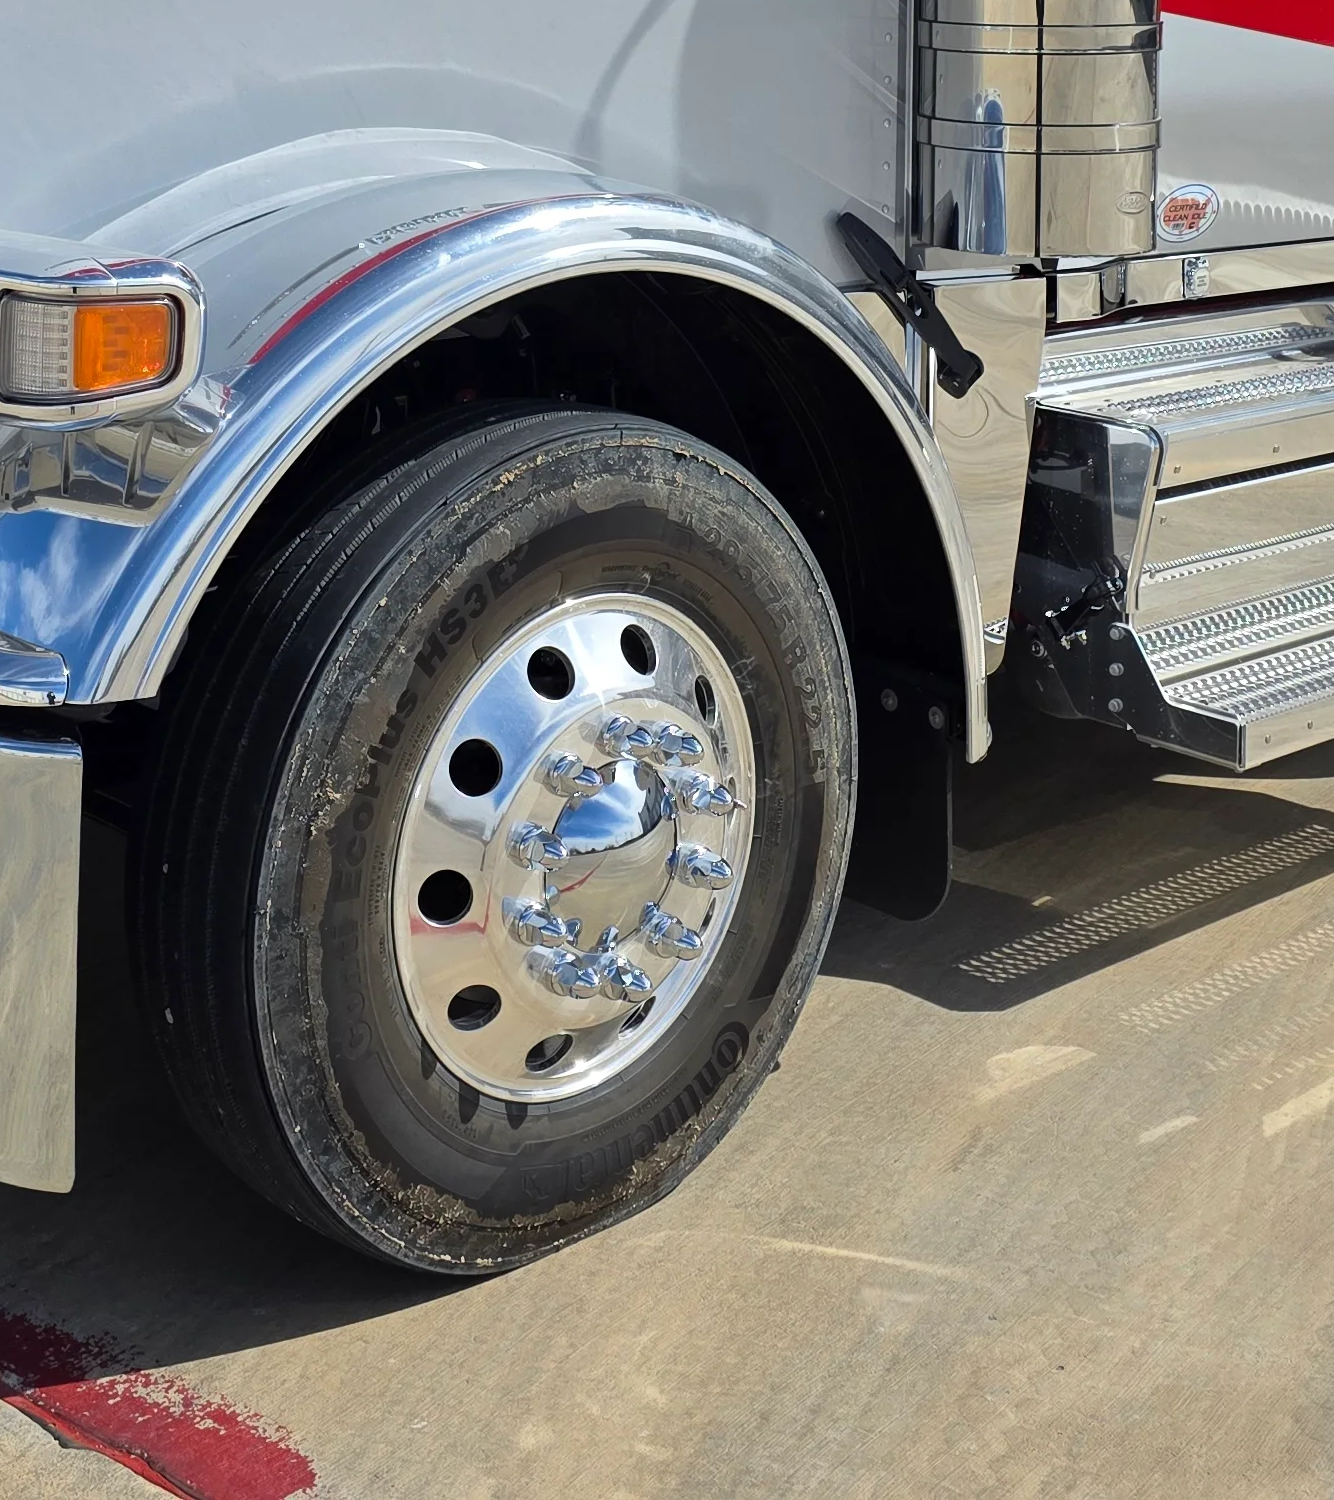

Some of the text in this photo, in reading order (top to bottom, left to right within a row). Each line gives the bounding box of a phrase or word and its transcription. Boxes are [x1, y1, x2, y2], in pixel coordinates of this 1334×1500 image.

[1169, 202, 1207, 213] CERTIFIED
[1163, 211, 1209, 222] CLEAN IDLE
[560, 1021, 750, 1198] Continental
